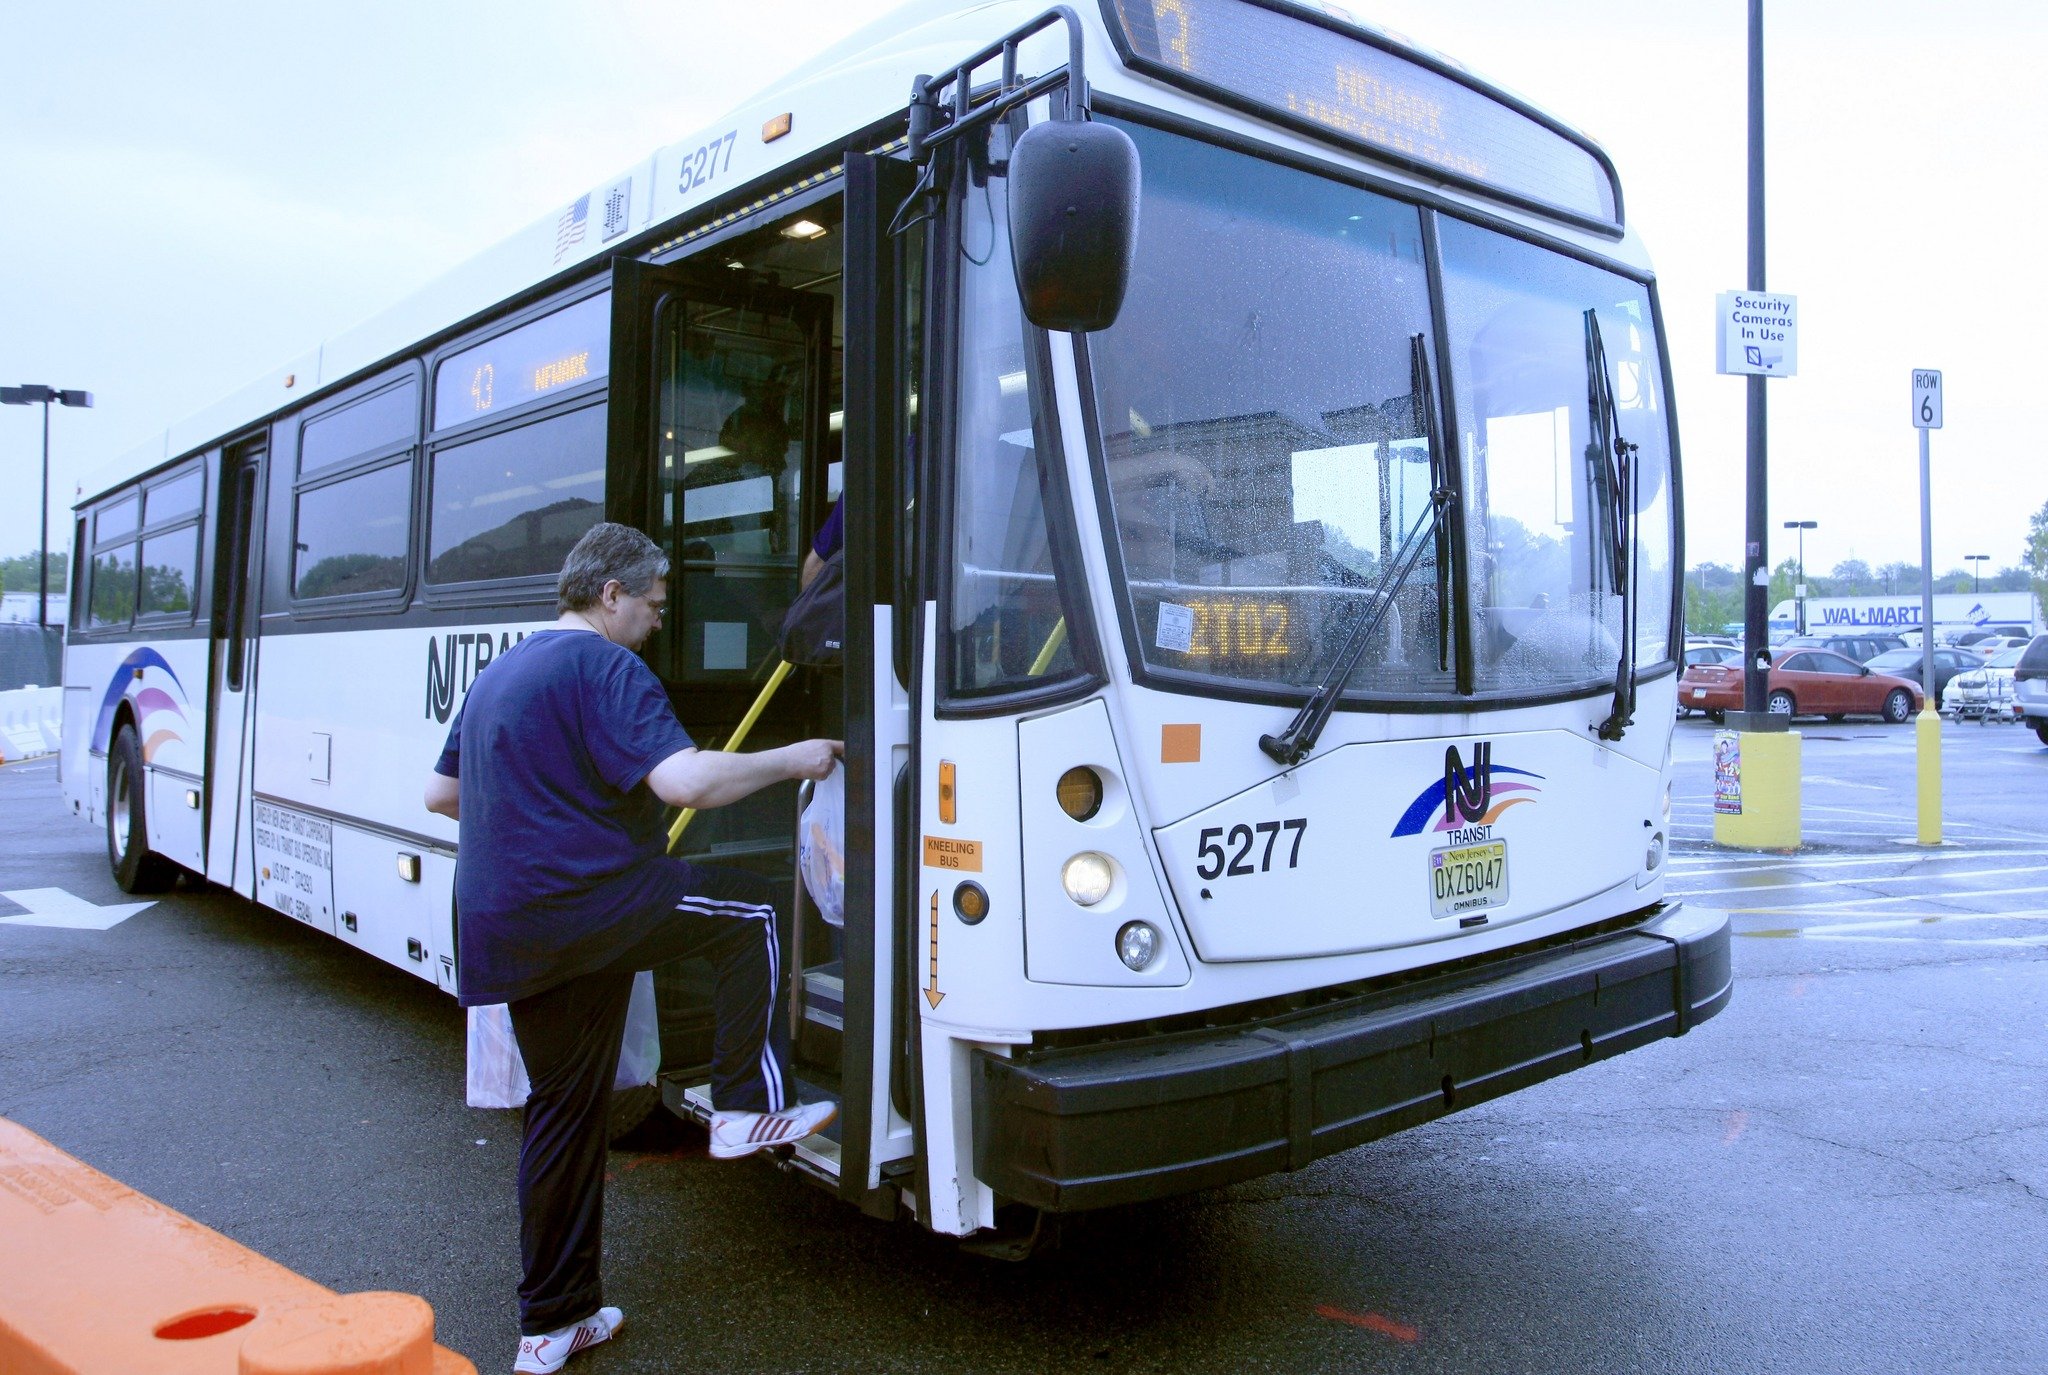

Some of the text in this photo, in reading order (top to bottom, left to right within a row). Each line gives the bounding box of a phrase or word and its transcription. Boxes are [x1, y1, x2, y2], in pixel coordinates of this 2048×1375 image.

[678, 129, 738, 195] 5277
[1735, 296, 1790, 315] Security
[1732, 311, 1793, 327] Cameras
[1741, 327, 1784, 341] In Use
[471, 363, 494, 412] 43
[1916, 374, 1938, 389] ROW
[1921, 395, 1933, 423] 6
[425, 634, 458, 725] NJ
[1445, 741, 1492, 824] NJ
[1447, 825, 1493, 846] TRANSIT
[927, 839, 975, 855] KNEELING
[1196, 817, 1308, 881] 5277
[1449, 848, 1488, 862] New Jersey
[940, 854, 959, 868] BUS
[1453, 896, 1488, 911] OMNIBUS
